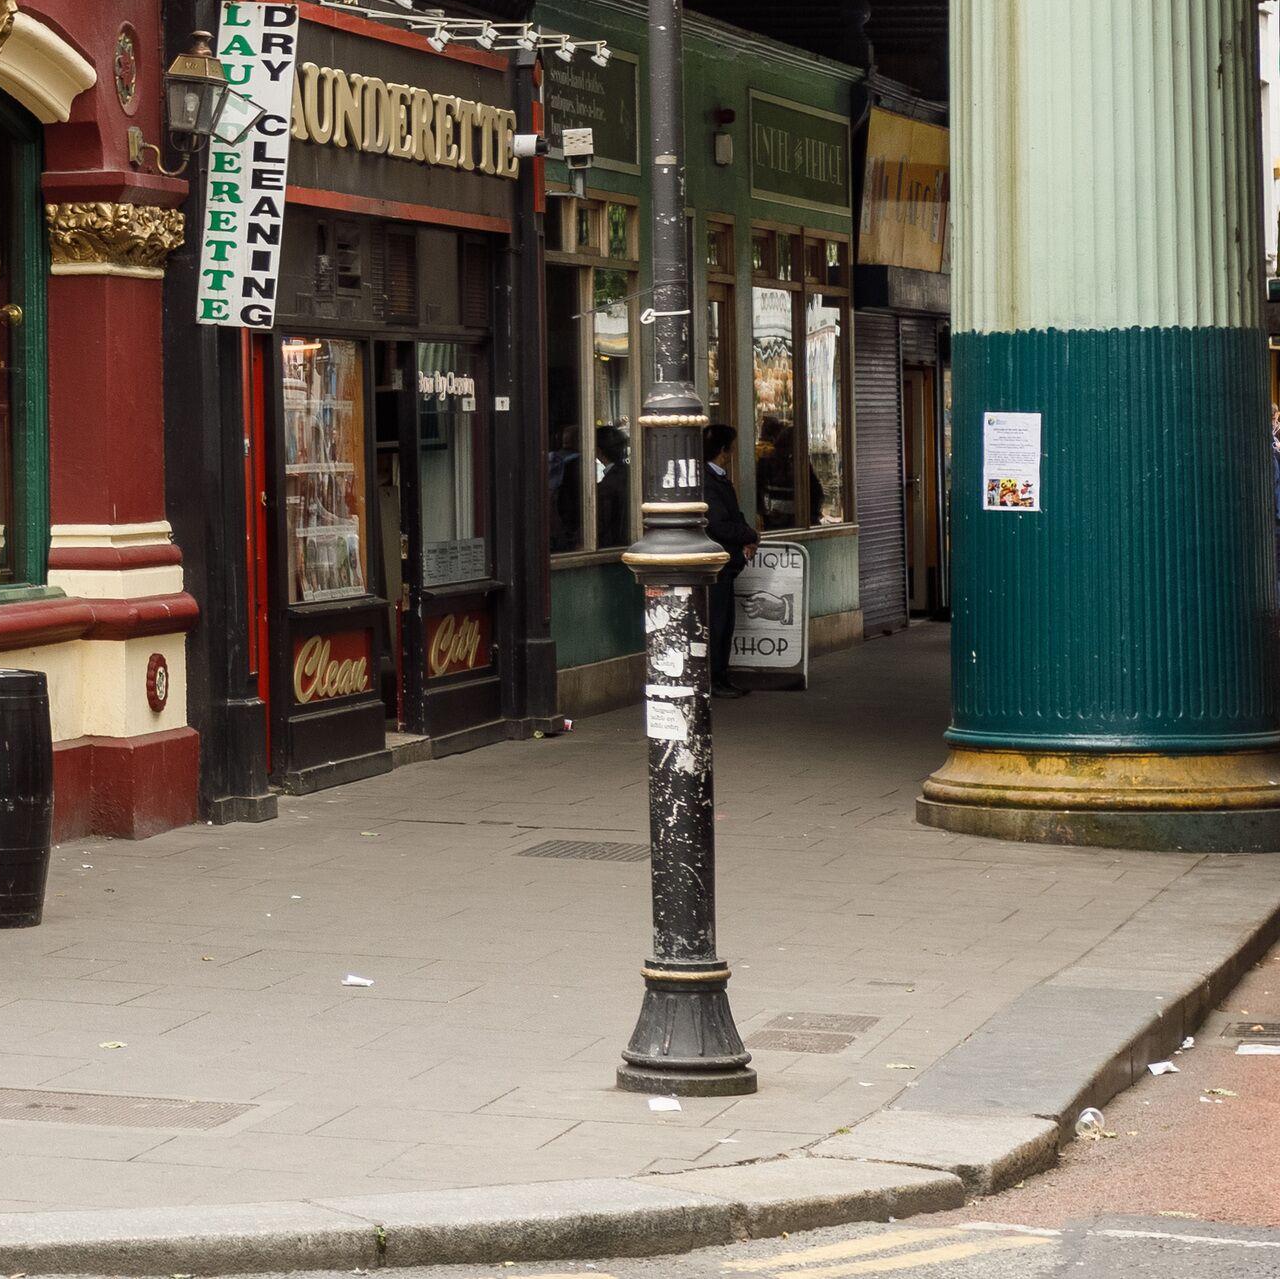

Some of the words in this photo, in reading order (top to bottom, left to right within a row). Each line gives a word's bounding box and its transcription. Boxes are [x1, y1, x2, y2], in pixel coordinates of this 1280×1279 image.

[260, 5, 297, 82] DRY
[291, 61, 520, 180] AUNDERETTE
[239, 114, 289, 327] CLEANING
[745, 552, 801, 570] TIQUE
[293, 634, 369, 704] Clean
[733, 636, 789, 656] SHOP
